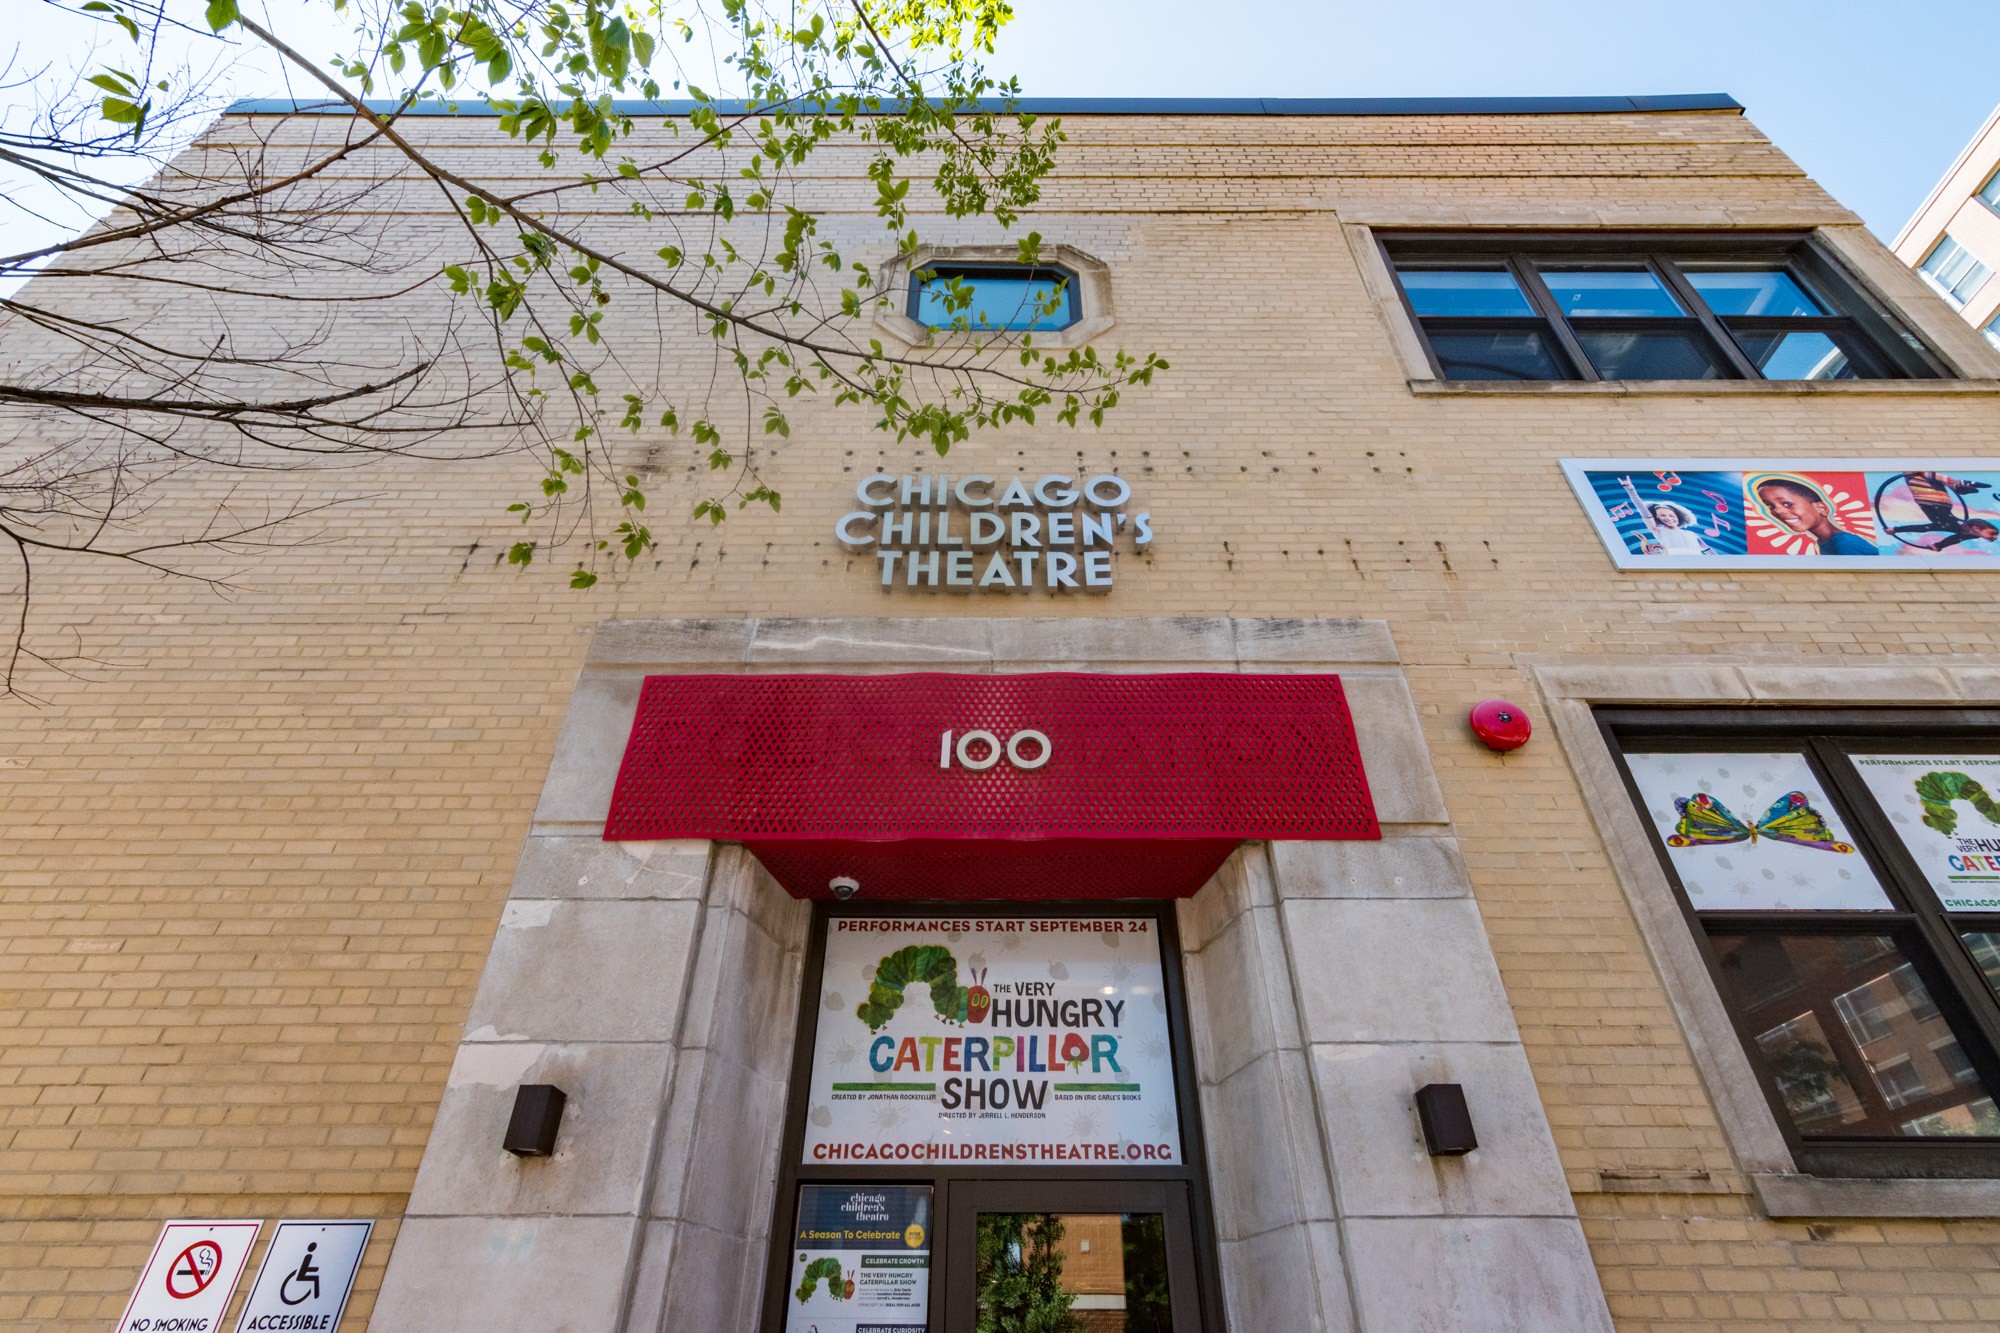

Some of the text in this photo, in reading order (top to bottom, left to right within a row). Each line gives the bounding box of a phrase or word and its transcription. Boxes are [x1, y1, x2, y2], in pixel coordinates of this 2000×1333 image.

[856, 475, 1131, 509] CHICAGO
[835, 511, 1153, 547] CHILDREN'S
[877, 551, 1113, 588] THEATRE
[940, 729, 1052, 772] 100
[1956, 838, 1975, 846] THE
[1974, 838, 2000, 852] HU
[1945, 899, 2000, 907] CHICAGO
[837, 920, 1148, 933] PERFORMANCES START SEPTEMBER 24
[993, 982, 1056, 997] THE VERY
[991, 998, 1126, 1028] HUNGRY
[941, 1078, 1049, 1110] SHOW
[812, 1143, 1173, 1161] CHICAGOCHILDRENSTHEATRE.ORG
[850, 1193, 886, 1203] chicago
[856, 1211, 890, 1221] theatre
[800, 1231, 807, 1239] A
[808, 1230, 842, 1239] Season
[843, 1230, 854, 1239] To
[855, 1230, 901, 1239] Celebrate
[129, 1318, 208, 1332] NO SMOKING
[247, 1314, 331, 1331] ACCESSIBLE
